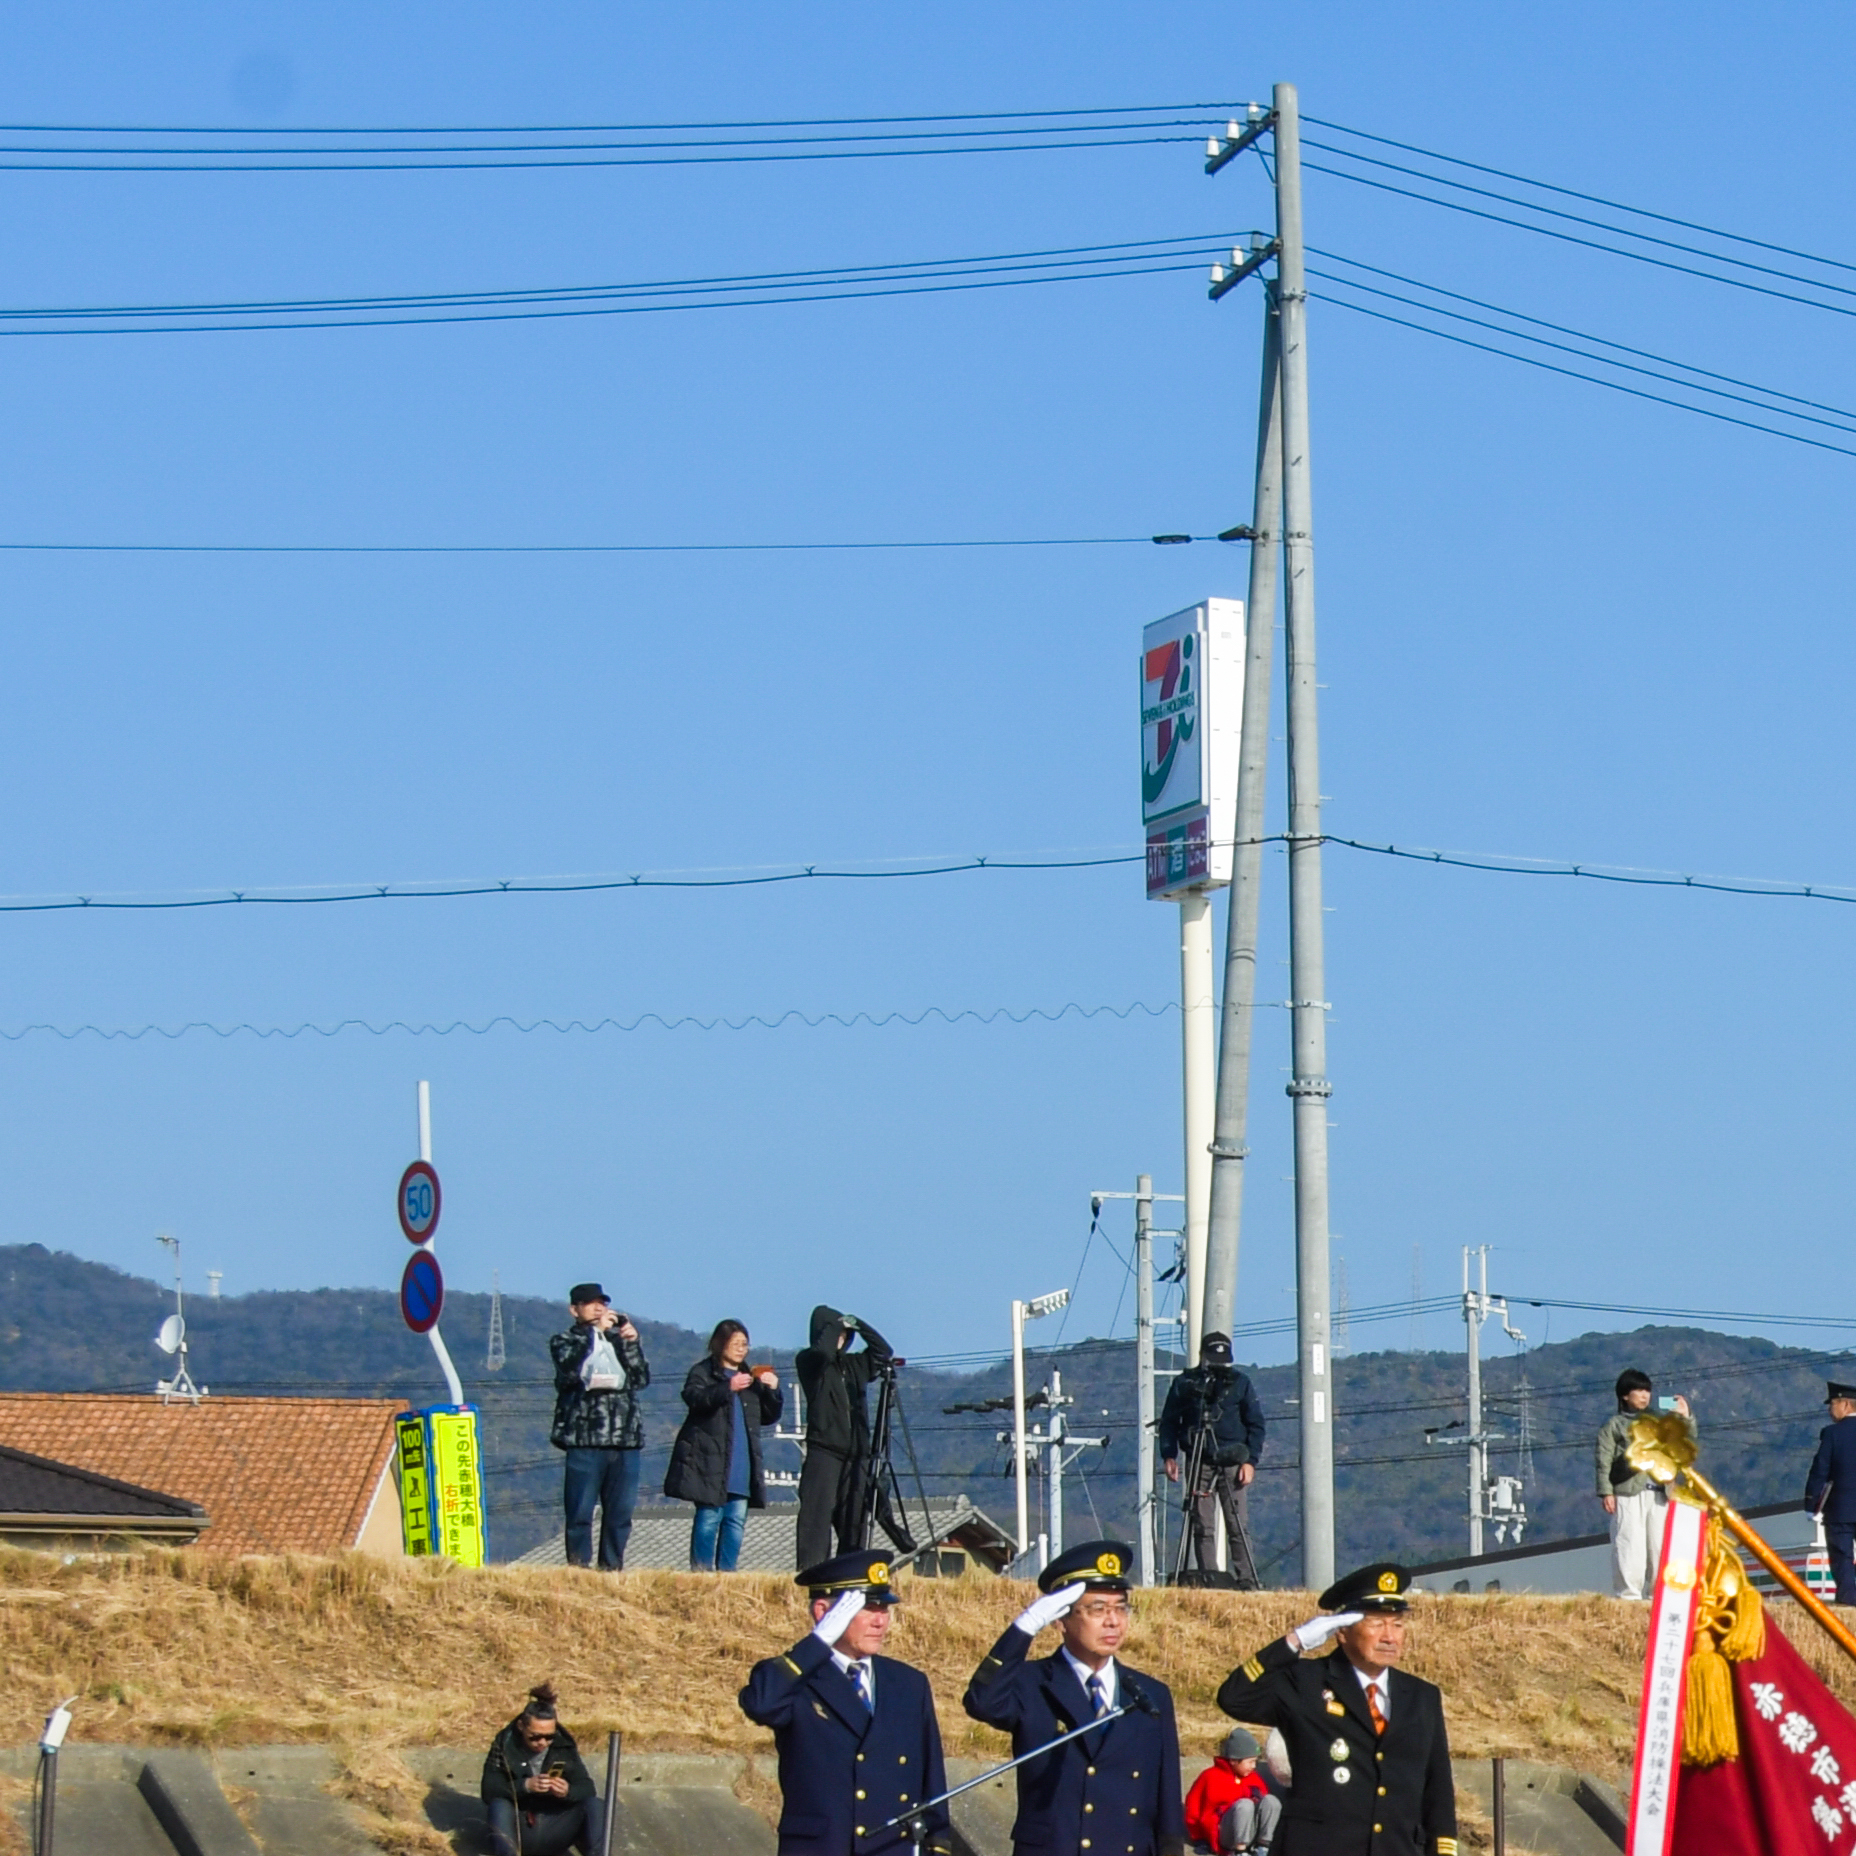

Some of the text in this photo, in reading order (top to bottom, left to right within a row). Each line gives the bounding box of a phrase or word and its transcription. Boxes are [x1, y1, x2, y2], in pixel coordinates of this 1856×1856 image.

[1166, 691, 1195, 715] HOLDINGS
[407, 1183, 431, 1221] 50
[402, 1429, 421, 1448] 100
[456, 1424, 476, 1527] この先赤穂大橋
[445, 1484, 461, 1564] 右折できま
